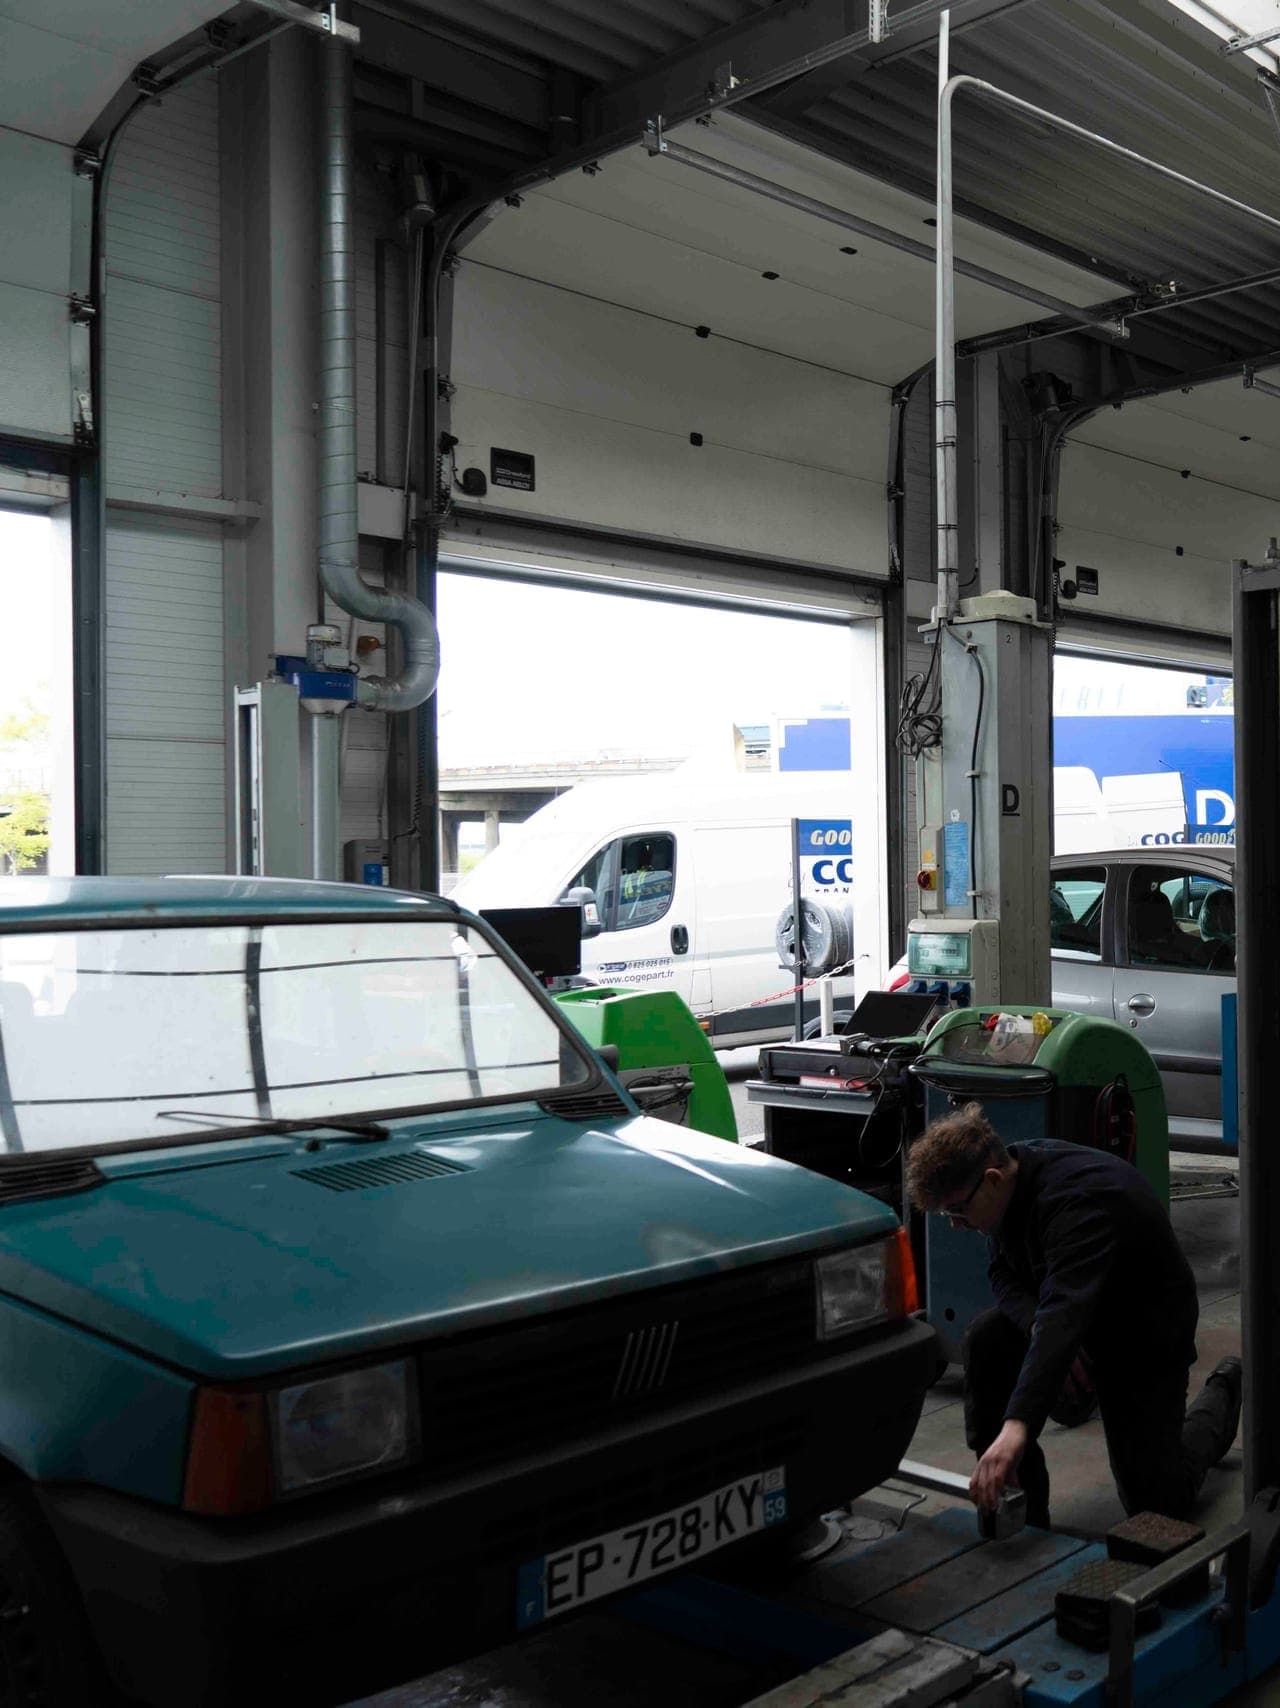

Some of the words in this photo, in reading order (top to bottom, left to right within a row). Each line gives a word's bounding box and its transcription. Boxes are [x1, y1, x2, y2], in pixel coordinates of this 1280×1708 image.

[1002, 784, 1020, 812] D
[810, 829, 851, 846] GOO
[598, 969, 675, 985] www.cogepart.fr
[765, 1495, 786, 1523] 59
